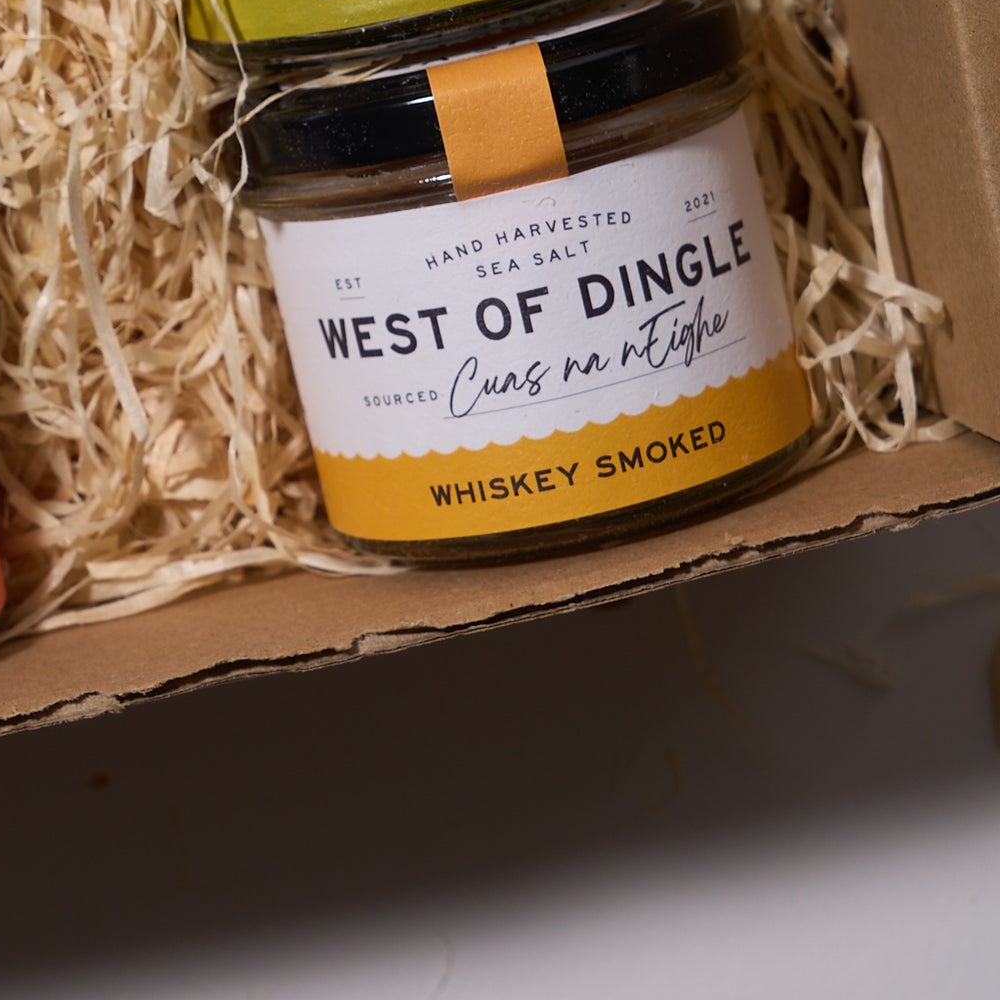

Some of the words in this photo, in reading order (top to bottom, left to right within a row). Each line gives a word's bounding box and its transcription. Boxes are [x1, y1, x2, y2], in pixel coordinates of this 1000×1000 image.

[683, 192, 717, 212] 2021
[424, 238, 483, 271] HAND
[495, 210, 633, 246] HARVESTED
[475, 260, 520, 280] SEA
[532, 240, 592, 268] SALT
[317, 306, 449, 360] WEST
[475, 286, 551, 341] OF
[577, 219, 752, 320] DINGLE
[334, 276, 362, 292] EST
[363, 389, 439, 408] SOURCED
[448, 355, 551, 418] Cuas
[562, 351, 611, 383] na
[429, 461, 581, 507] WHISKEY
[595, 419, 727, 479] SMOKED
